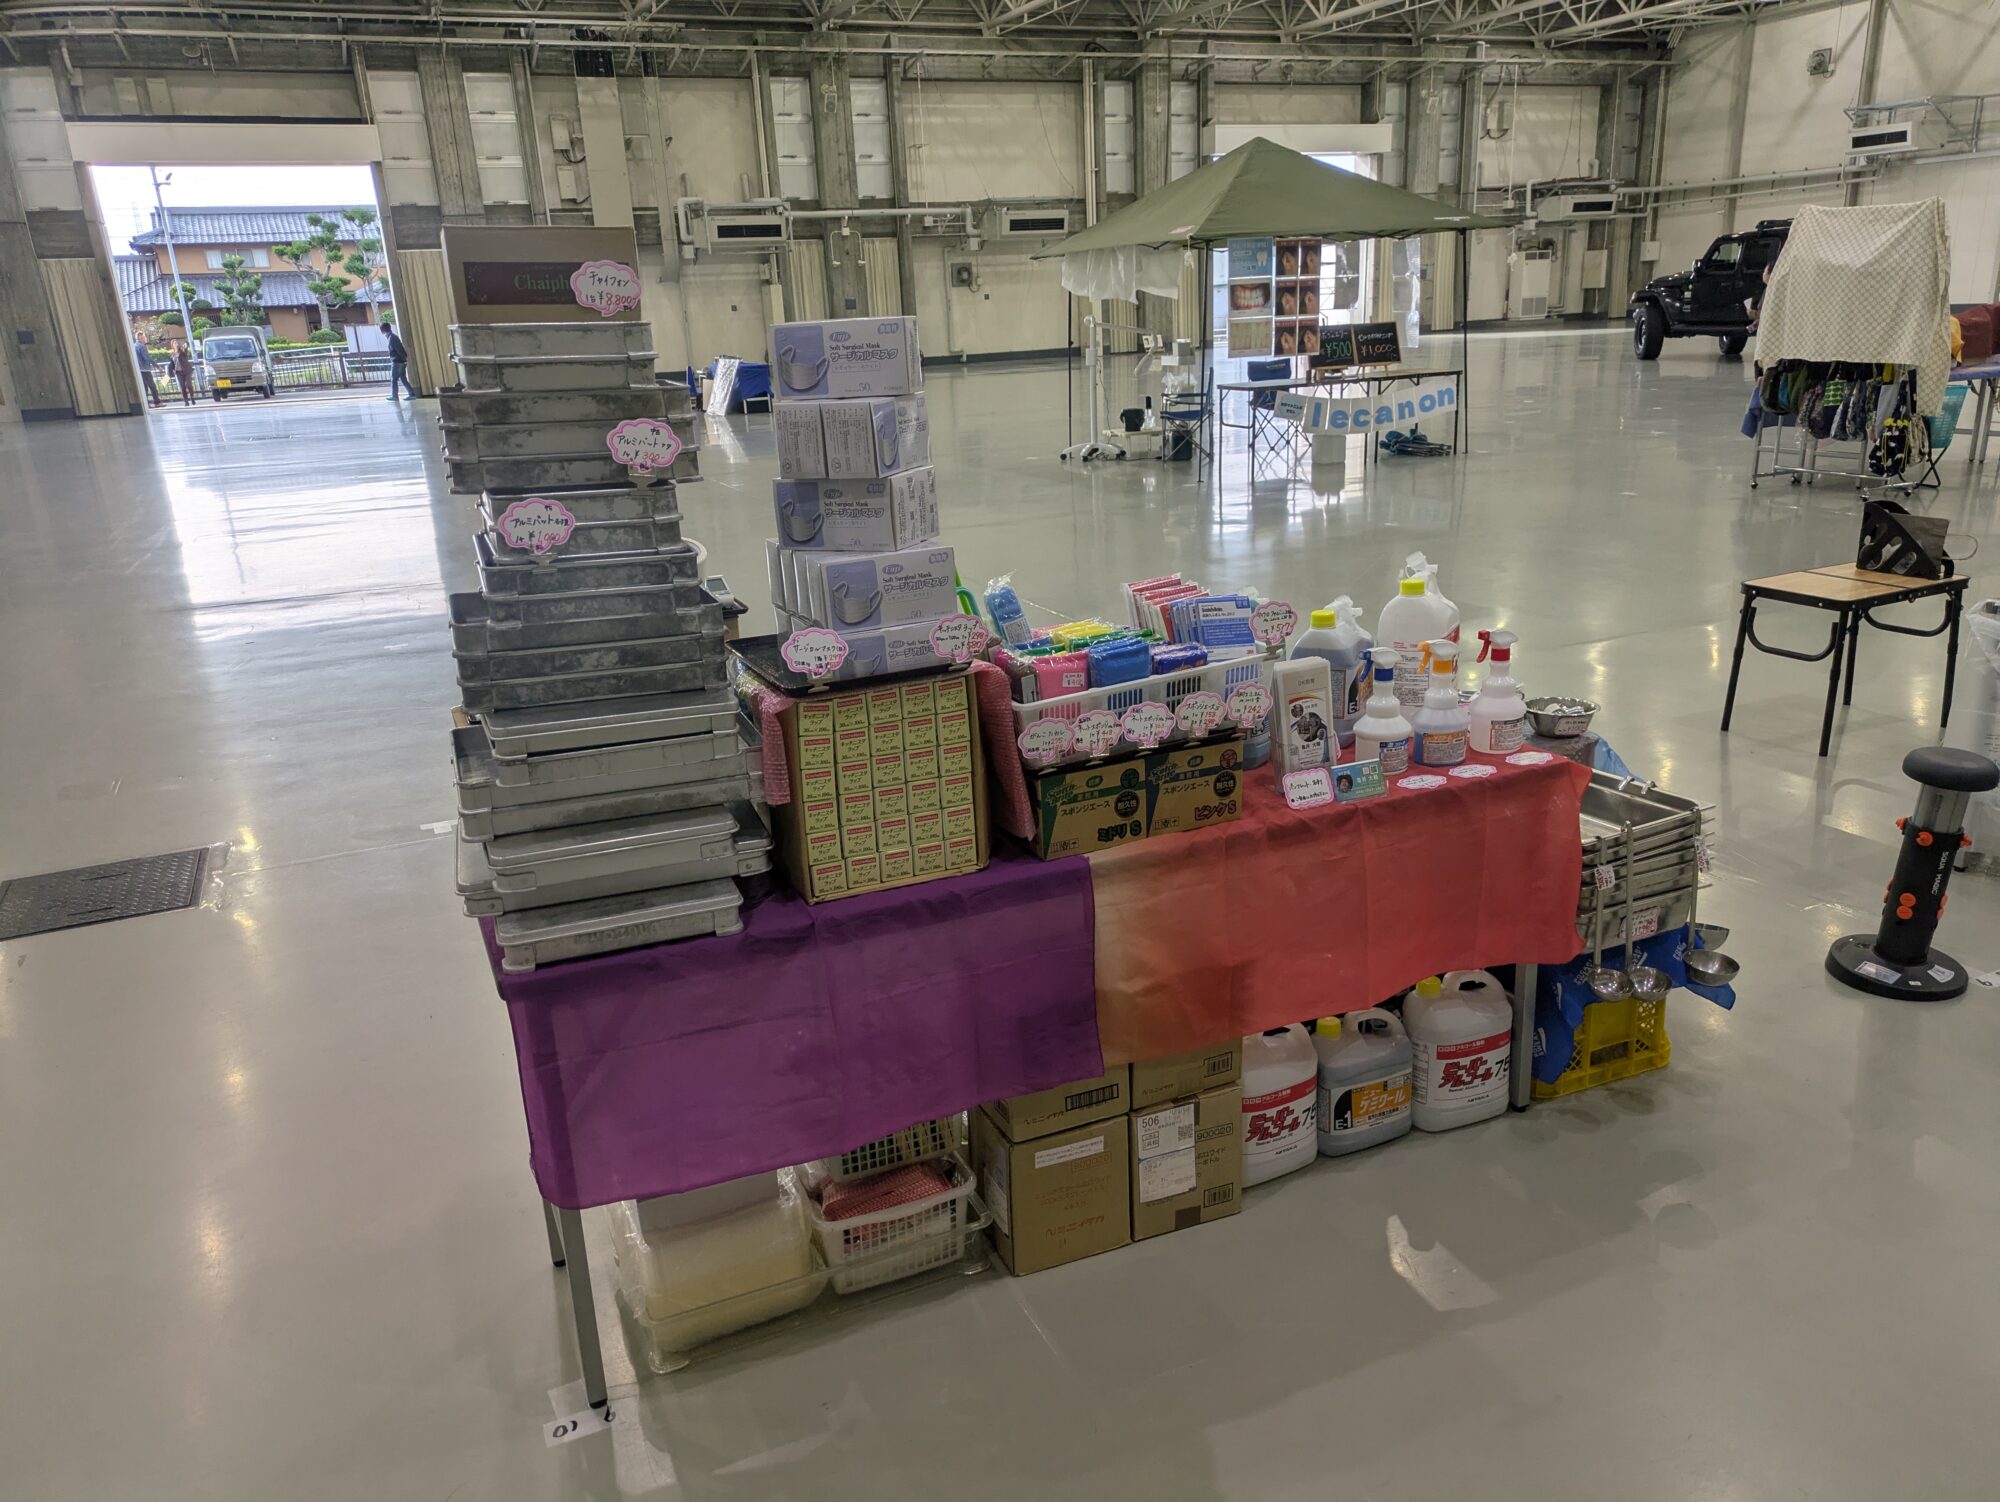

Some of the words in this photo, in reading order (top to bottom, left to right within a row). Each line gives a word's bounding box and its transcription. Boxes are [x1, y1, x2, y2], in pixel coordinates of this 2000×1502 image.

[514, 272, 572, 293] Chaiph
[830, 349, 898, 362] サージカルマスク
[1325, 341, 1352, 358] ¥500
[1312, 387, 1455, 429] lecanon
[824, 507, 885, 519] サージカルマスク
[883, 576, 949, 593] サージカルマスク
[1163, 780, 1210, 795] スポンジエース
[1061, 801, 1111, 817] スポンジエース
[1194, 802, 1227, 821] ピンク
[1227, 799, 1237, 815] S
[1097, 823, 1127, 842] ミドリ
[1129, 820, 1142, 836] S
[1142, 1116, 1159, 1129] 506
[1335, 1110, 1352, 1130] E-1
